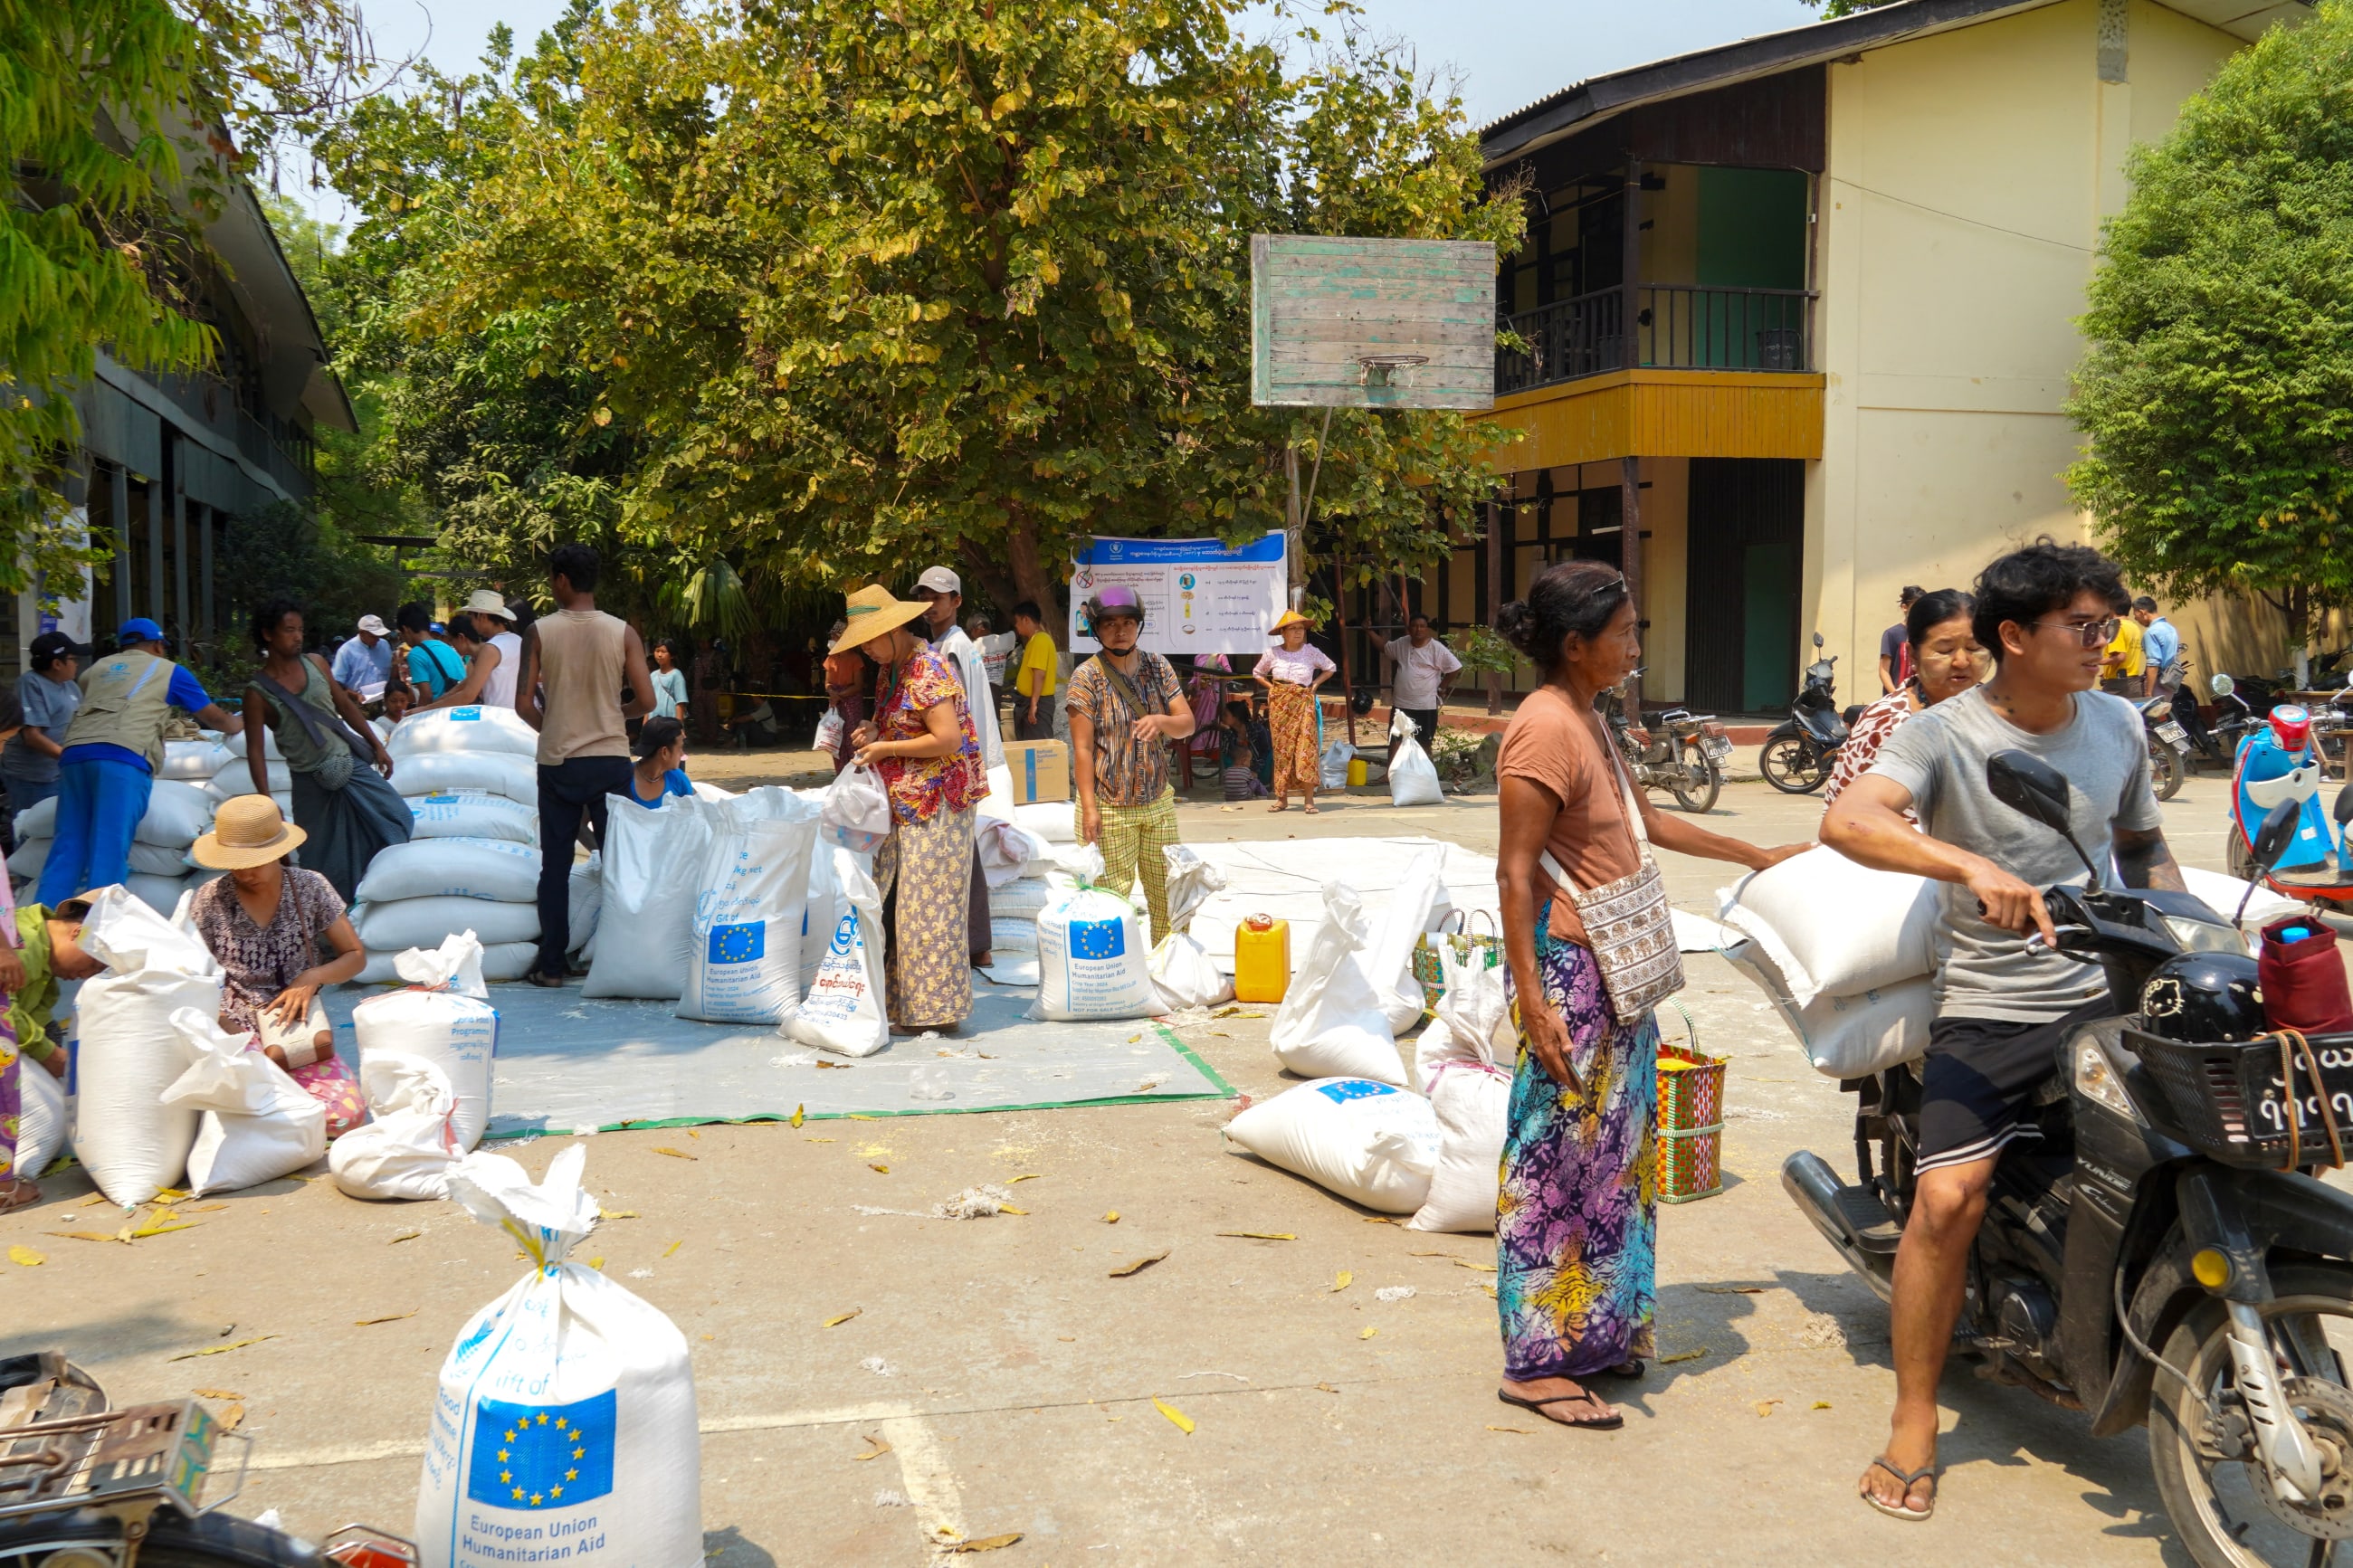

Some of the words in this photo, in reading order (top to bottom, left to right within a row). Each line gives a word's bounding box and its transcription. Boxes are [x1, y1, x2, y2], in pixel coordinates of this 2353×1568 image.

[710, 968, 738, 976] European
[739, 964, 758, 974] Union
[1072, 972, 1115, 980] Humanitarian
[1116, 968, 1126, 976] Aid
[1074, 963, 1104, 972] European
[1105, 962, 1122, 971] Union
[529, 1373, 551, 1396] of
[470, 1514, 543, 1542] European
[549, 1516, 597, 1538] Union
[462, 1535, 571, 1563] Humanitarian
[576, 1533, 605, 1555] Aid
